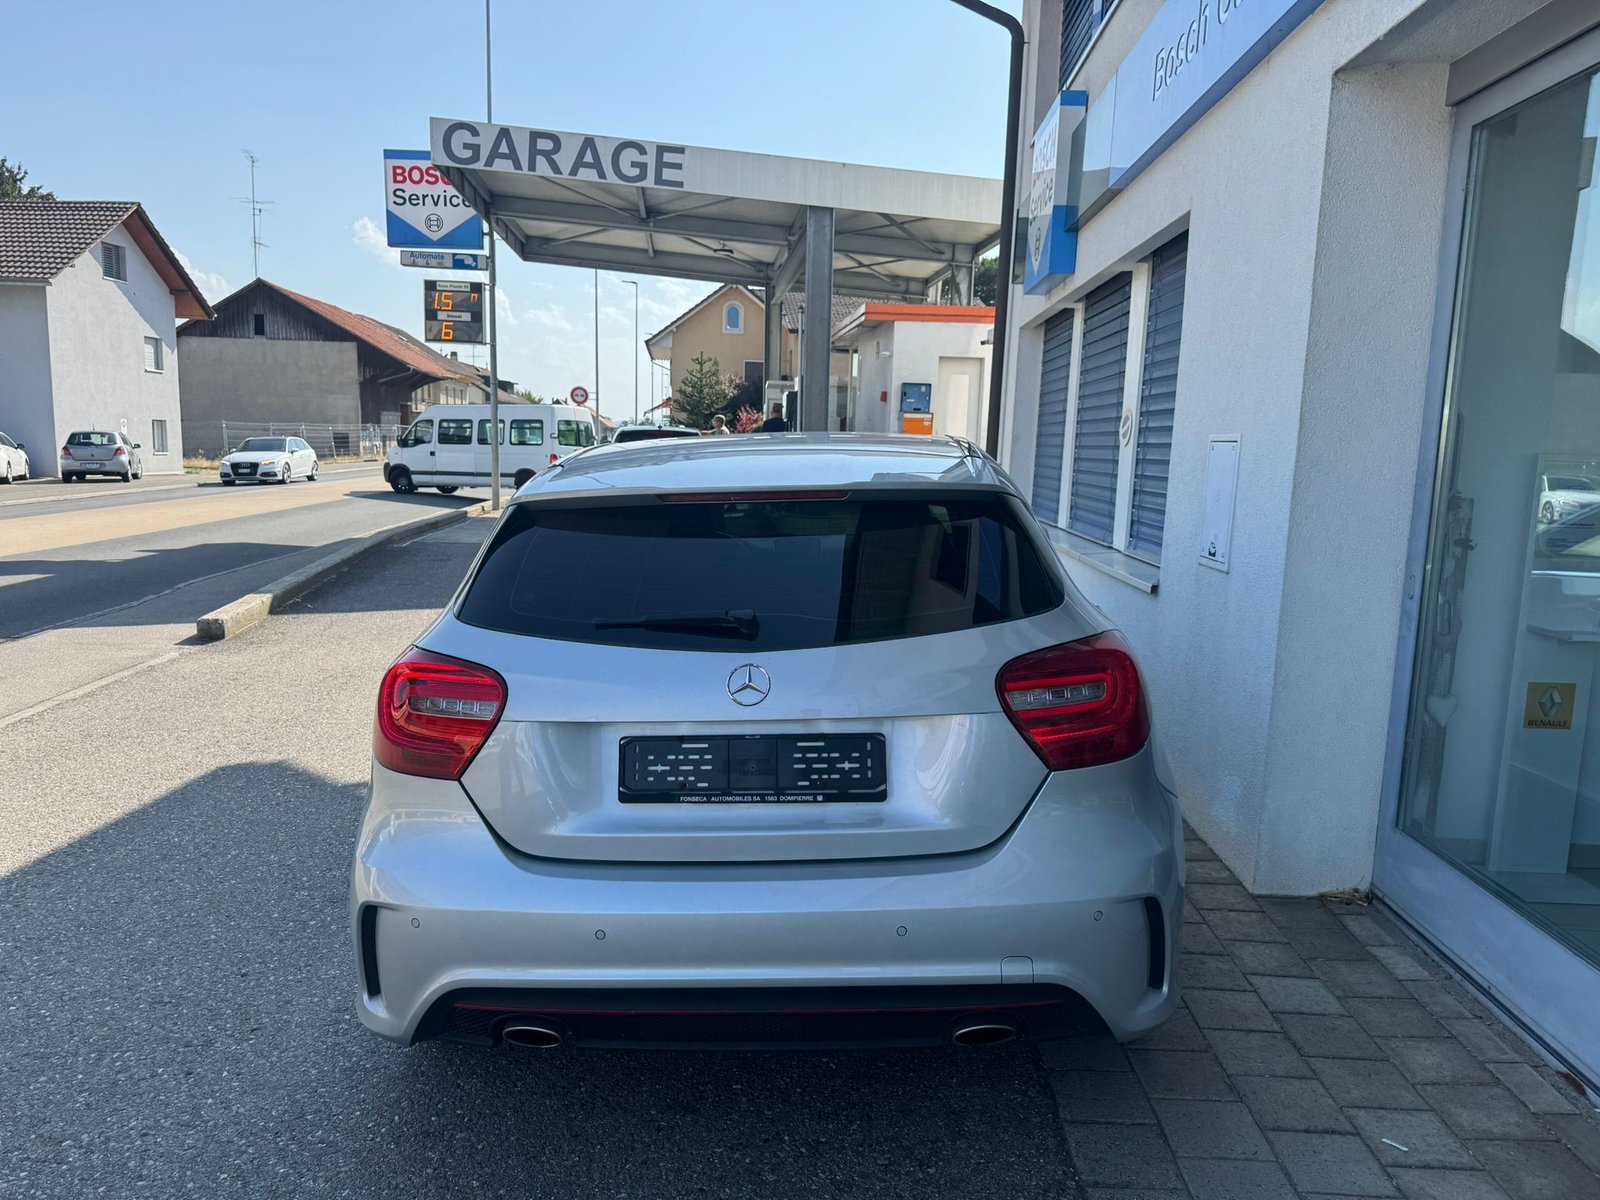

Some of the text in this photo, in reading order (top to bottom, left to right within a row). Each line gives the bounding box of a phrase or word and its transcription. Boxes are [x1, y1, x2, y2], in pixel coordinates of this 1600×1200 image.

[1152, 0, 1209, 102] Bosch
[442, 122, 686, 189] GARAGE
[392, 165, 451, 185] BOS
[409, 251, 445, 260] Automate
[1527, 719, 1568, 727] RENAULT
